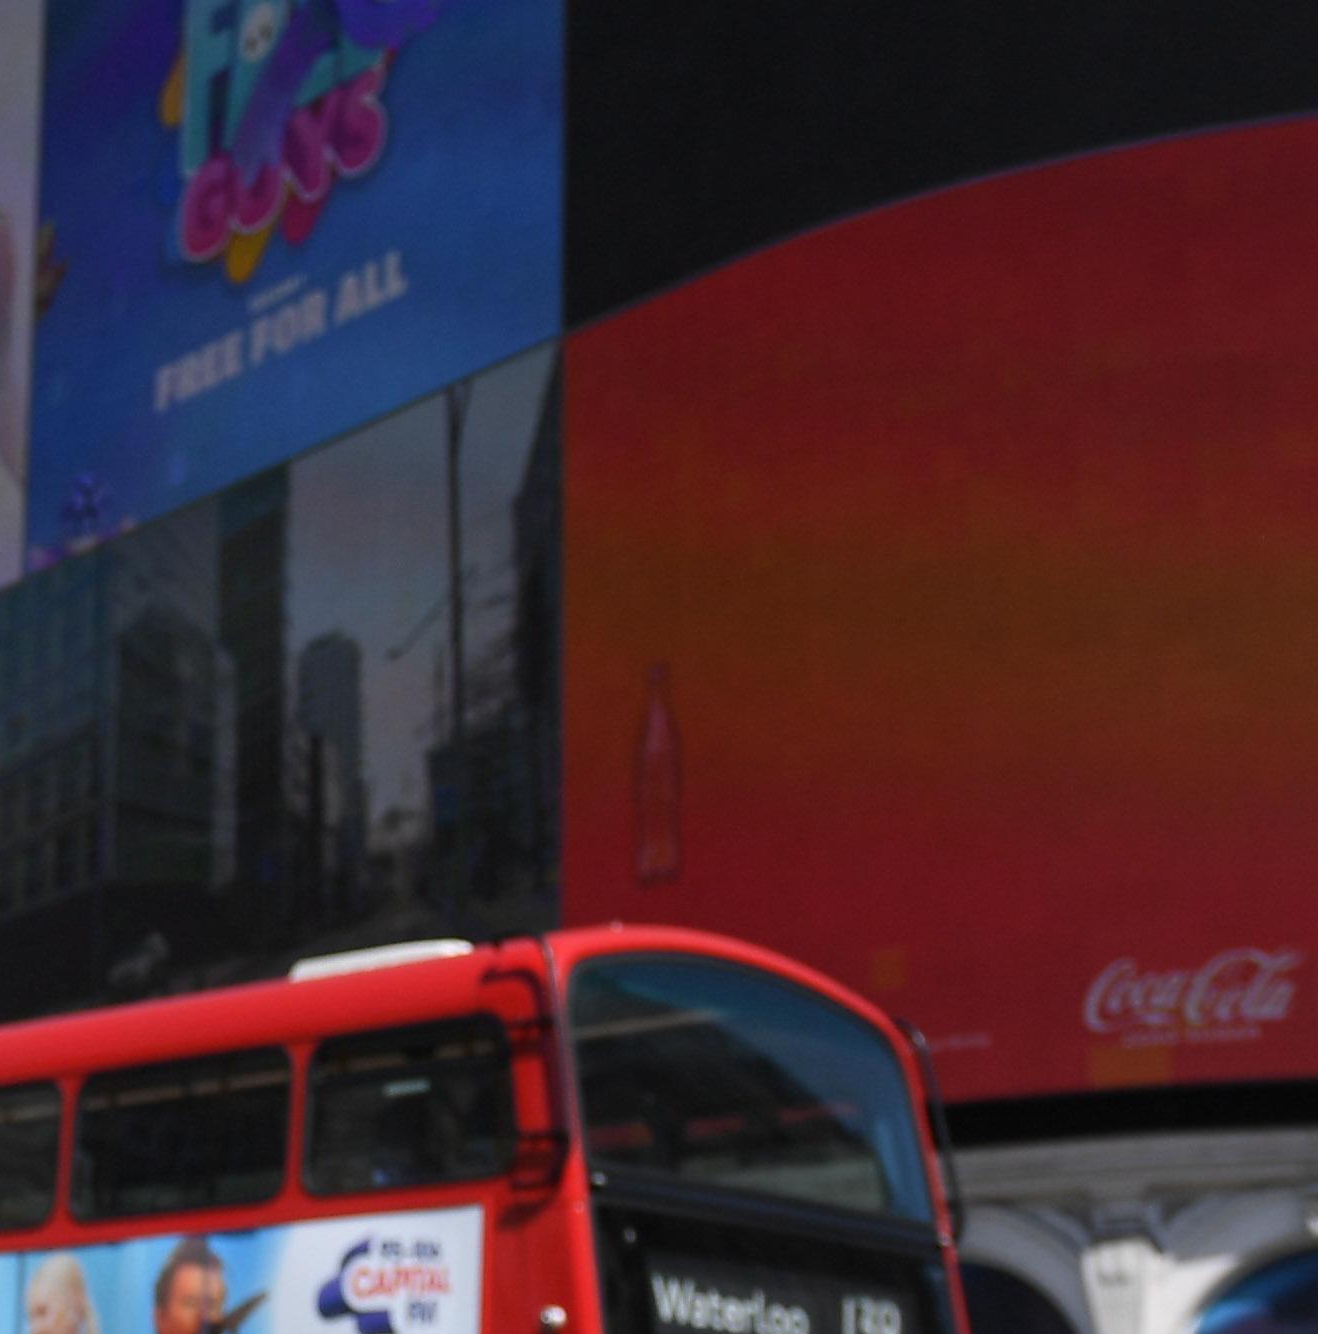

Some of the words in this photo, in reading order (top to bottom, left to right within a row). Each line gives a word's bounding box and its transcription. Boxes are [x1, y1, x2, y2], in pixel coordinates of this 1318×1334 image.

[154, 331, 243, 412] FREE
[250, 287, 327, 366] FOR
[334, 249, 409, 326] ALL
[351, 1263, 452, 1299] CAPITAL
